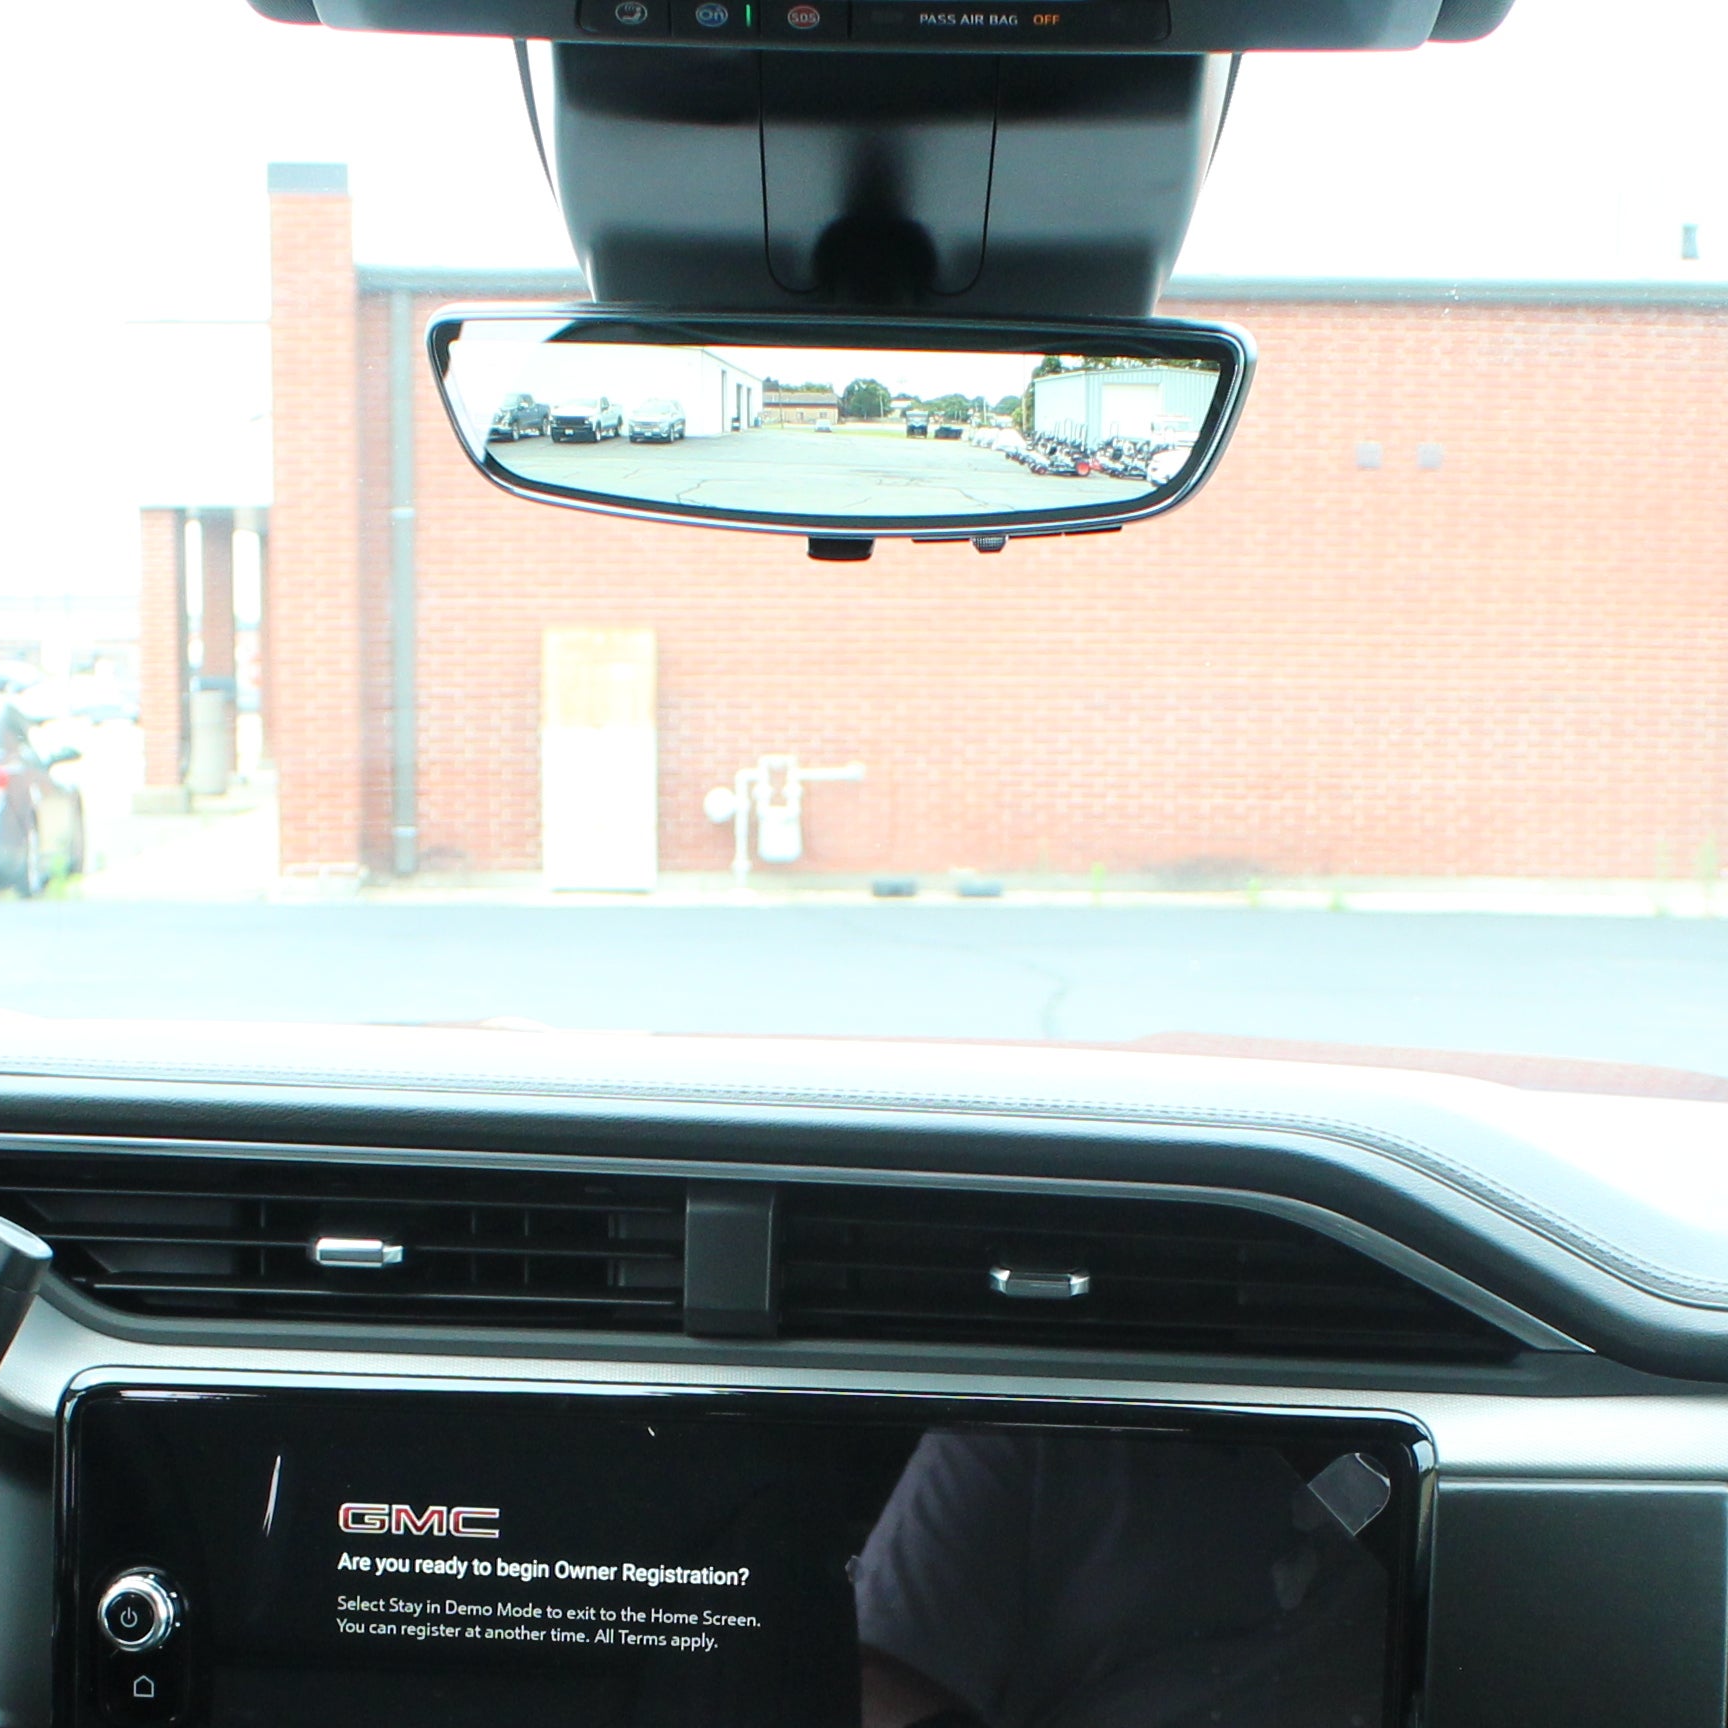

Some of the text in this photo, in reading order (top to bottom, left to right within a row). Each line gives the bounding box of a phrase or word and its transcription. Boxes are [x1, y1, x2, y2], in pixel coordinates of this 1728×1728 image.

[698, 8, 724, 20] On
[792, 12, 817, 21] SOS
[920, 13, 1061, 26] PASS AIR BAG OFF
[338, 1502, 501, 1539] GMC
[337, 1552, 751, 1587] Are you ready to begin Owner Registration?
[337, 1595, 762, 1628] Select Stay in Demo Mode to exit to the Home Screen.
[336, 1618, 720, 1653] You can register at another time. All Terms apply.
